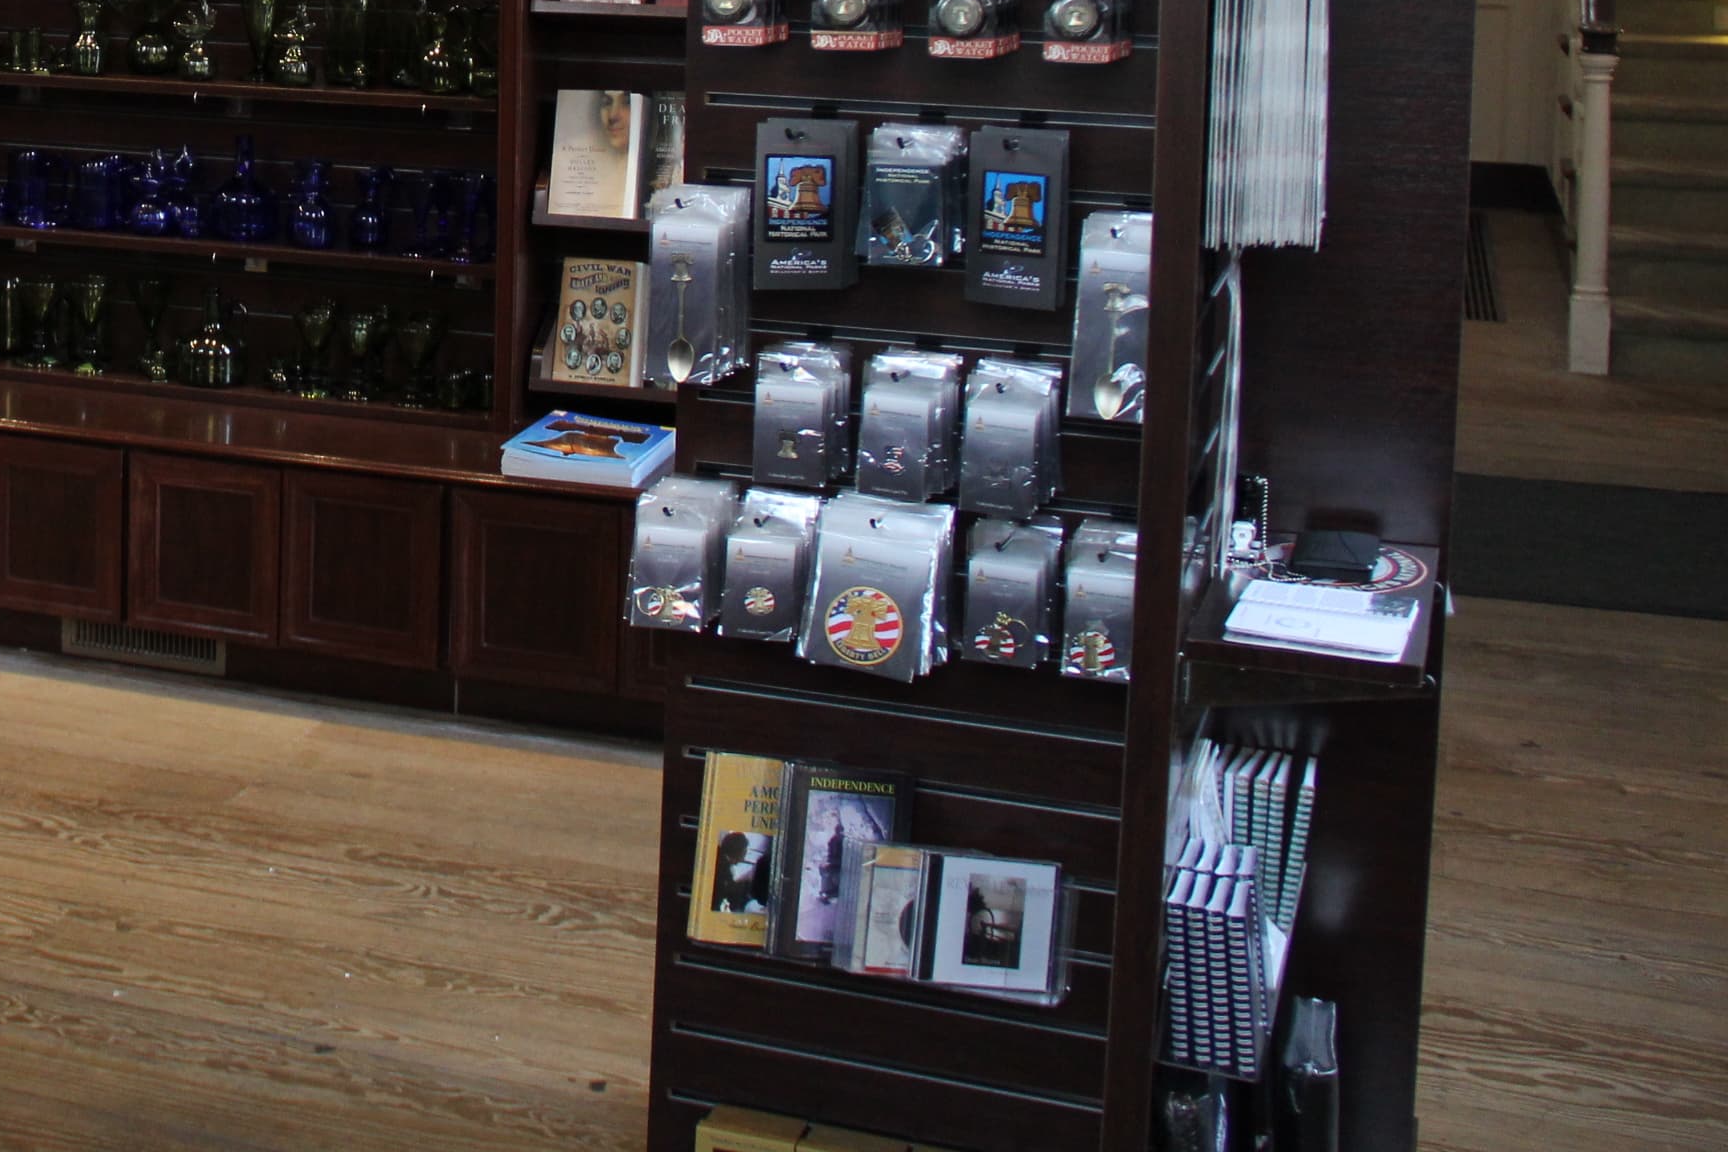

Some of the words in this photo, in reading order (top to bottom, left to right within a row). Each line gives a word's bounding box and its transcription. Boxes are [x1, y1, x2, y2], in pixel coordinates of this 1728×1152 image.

[726, 28, 762, 36] POCKET
[726, 36, 762, 44] WATCH
[838, 40, 874, 48] WATCH
[955, 48, 994, 56] WATCH
[1071, 45, 1108, 53] POCKET
[1072, 53, 1109, 62] WATCH
[982, 231, 1042, 242] INDEPENDENCE
[994, 239, 1030, 248] NATIONAL
[770, 258, 828, 266] AMERICA'S
[570, 264, 604, 273] CIVIL
[607, 265, 632, 276] WAR
[984, 272, 1040, 283] AMERICA'S
[867, 649, 886, 660] BELL
[810, 777, 895, 794] INDEPENDENCE
